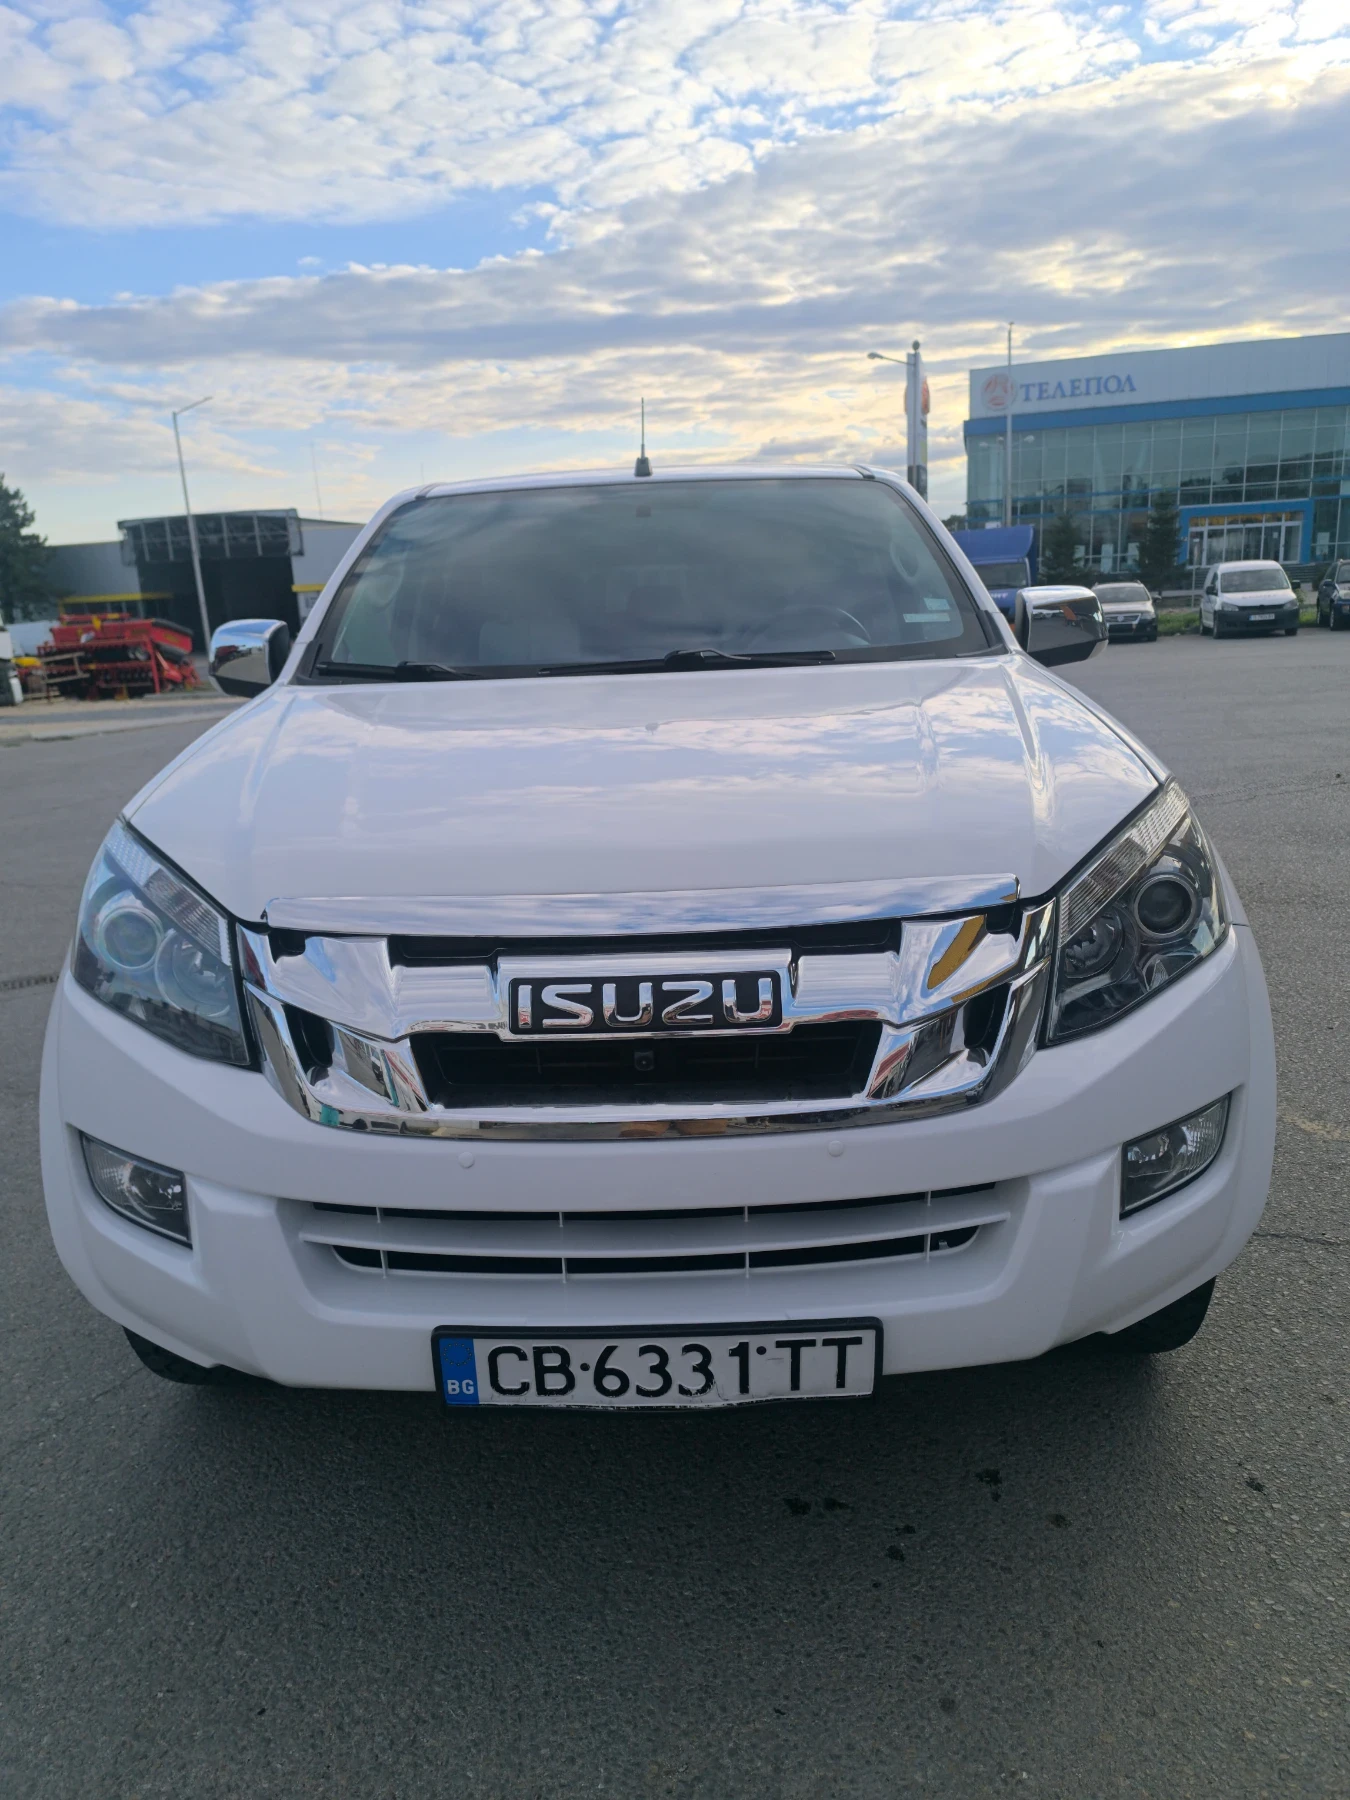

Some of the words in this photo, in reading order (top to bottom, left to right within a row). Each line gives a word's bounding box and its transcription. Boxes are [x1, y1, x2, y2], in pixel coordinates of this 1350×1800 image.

[1020, 374, 1136, 402] ТЕЛЕПОЛ
[517, 977, 773, 1029] ISUZU
[447, 1379, 476, 1396] BG
